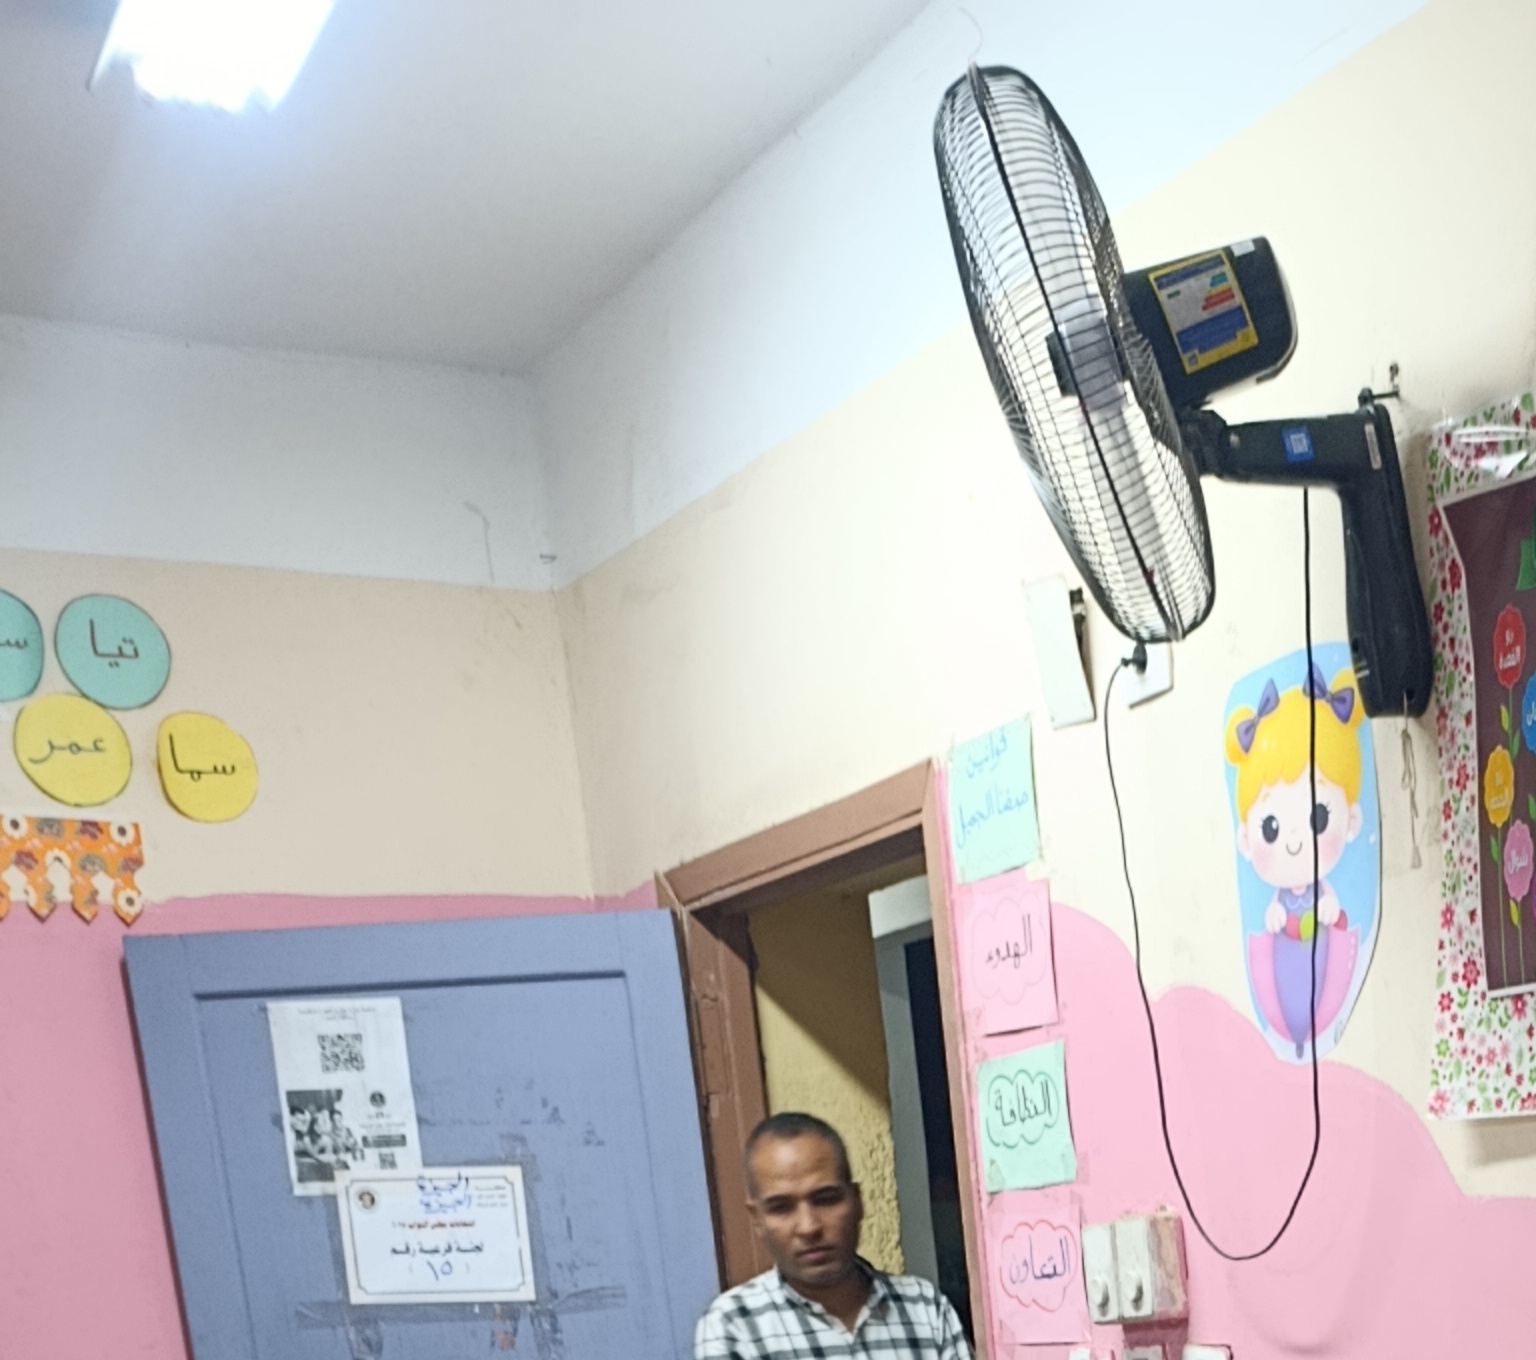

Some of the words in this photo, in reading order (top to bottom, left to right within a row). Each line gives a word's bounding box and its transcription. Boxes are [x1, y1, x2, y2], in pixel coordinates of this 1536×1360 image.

[28, 737, 107, 765] عمر
[1508, 849, 1529, 876] شوال
[985, 912, 1033, 970] الهدوء
[994, 1078, 1053, 1128] النظافة
[1009, 1234, 1071, 1285] التعاون
